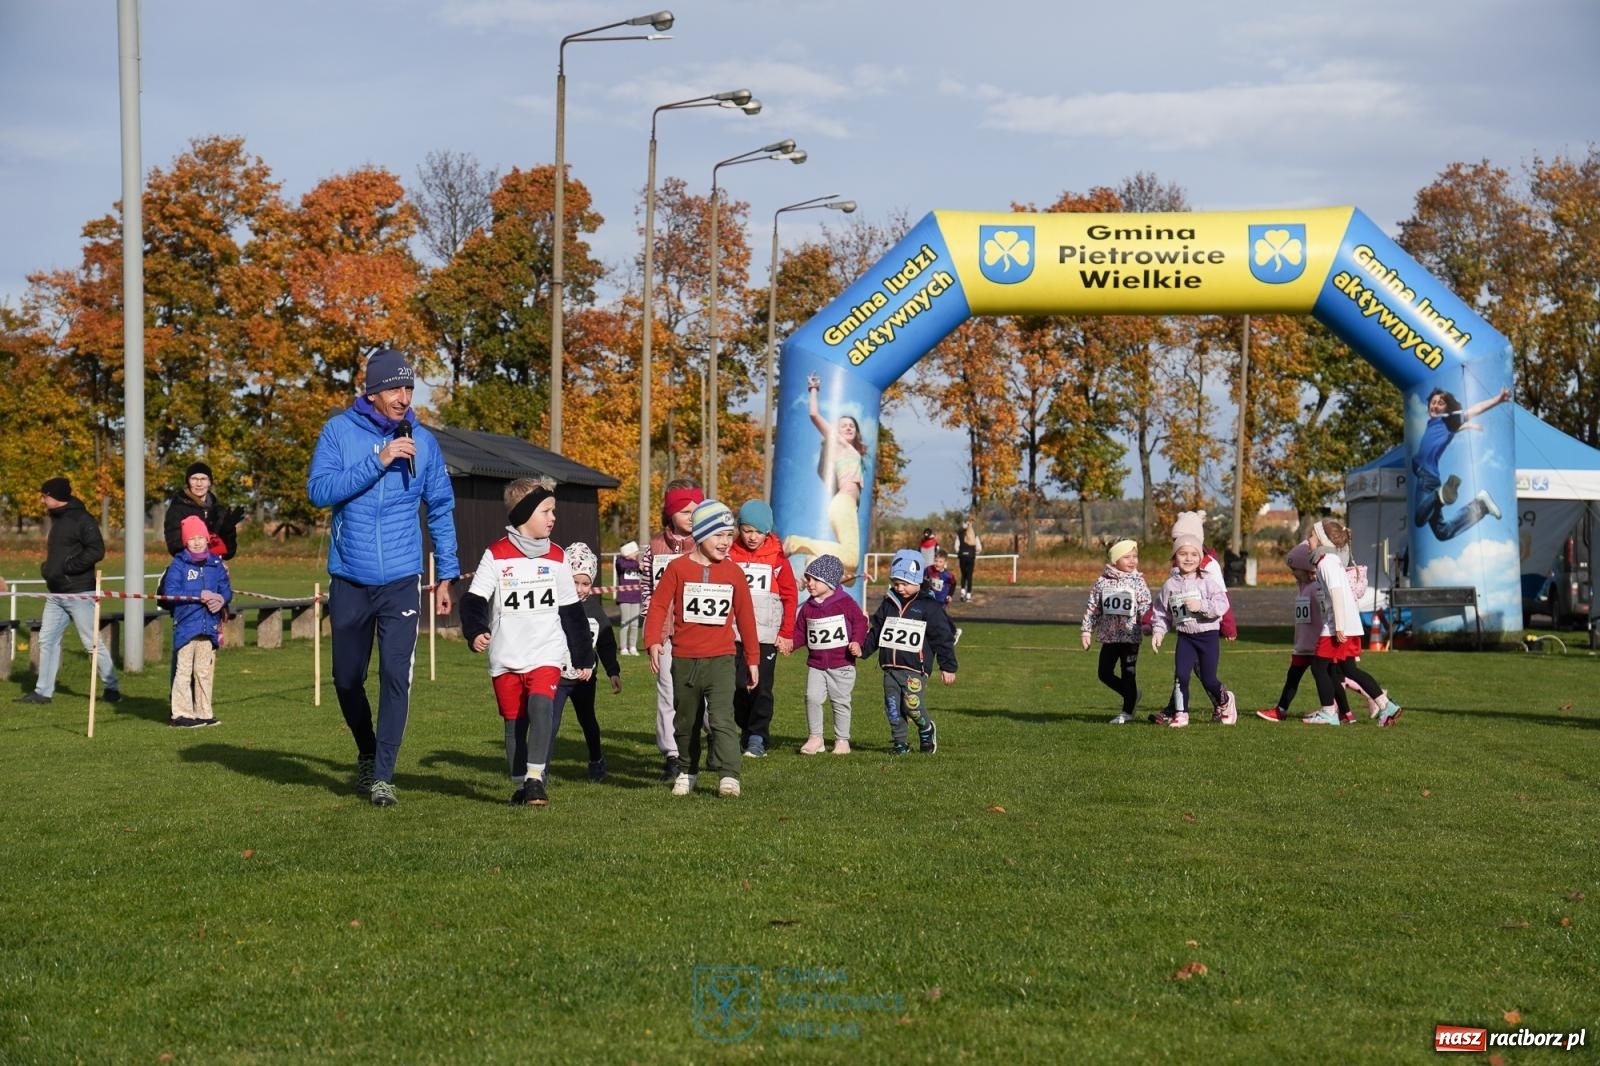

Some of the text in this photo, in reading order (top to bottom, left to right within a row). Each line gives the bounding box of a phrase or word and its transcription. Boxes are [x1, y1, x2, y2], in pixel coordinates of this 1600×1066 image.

[1086, 225, 1196, 241] Gmina
[1058, 245, 1226, 265] Pietrowice
[1078, 269, 1203, 289] Wielkie
[823, 244, 938, 346] Gmina ludzi
[1352, 244, 1472, 350] Gmina ludzi
[847, 271, 955, 366] aktywnych
[1332, 271, 1444, 371] aktywnych
[745, 574, 767, 590] 21
[504, 588, 555, 610] 414
[686, 597, 731, 617] 432
[1103, 596, 1133, 611] 408
[1171, 603, 1187, 618] 51
[1295, 606, 1309, 618] 00
[808, 626, 846, 644] 524
[882, 627, 921, 647] 520
